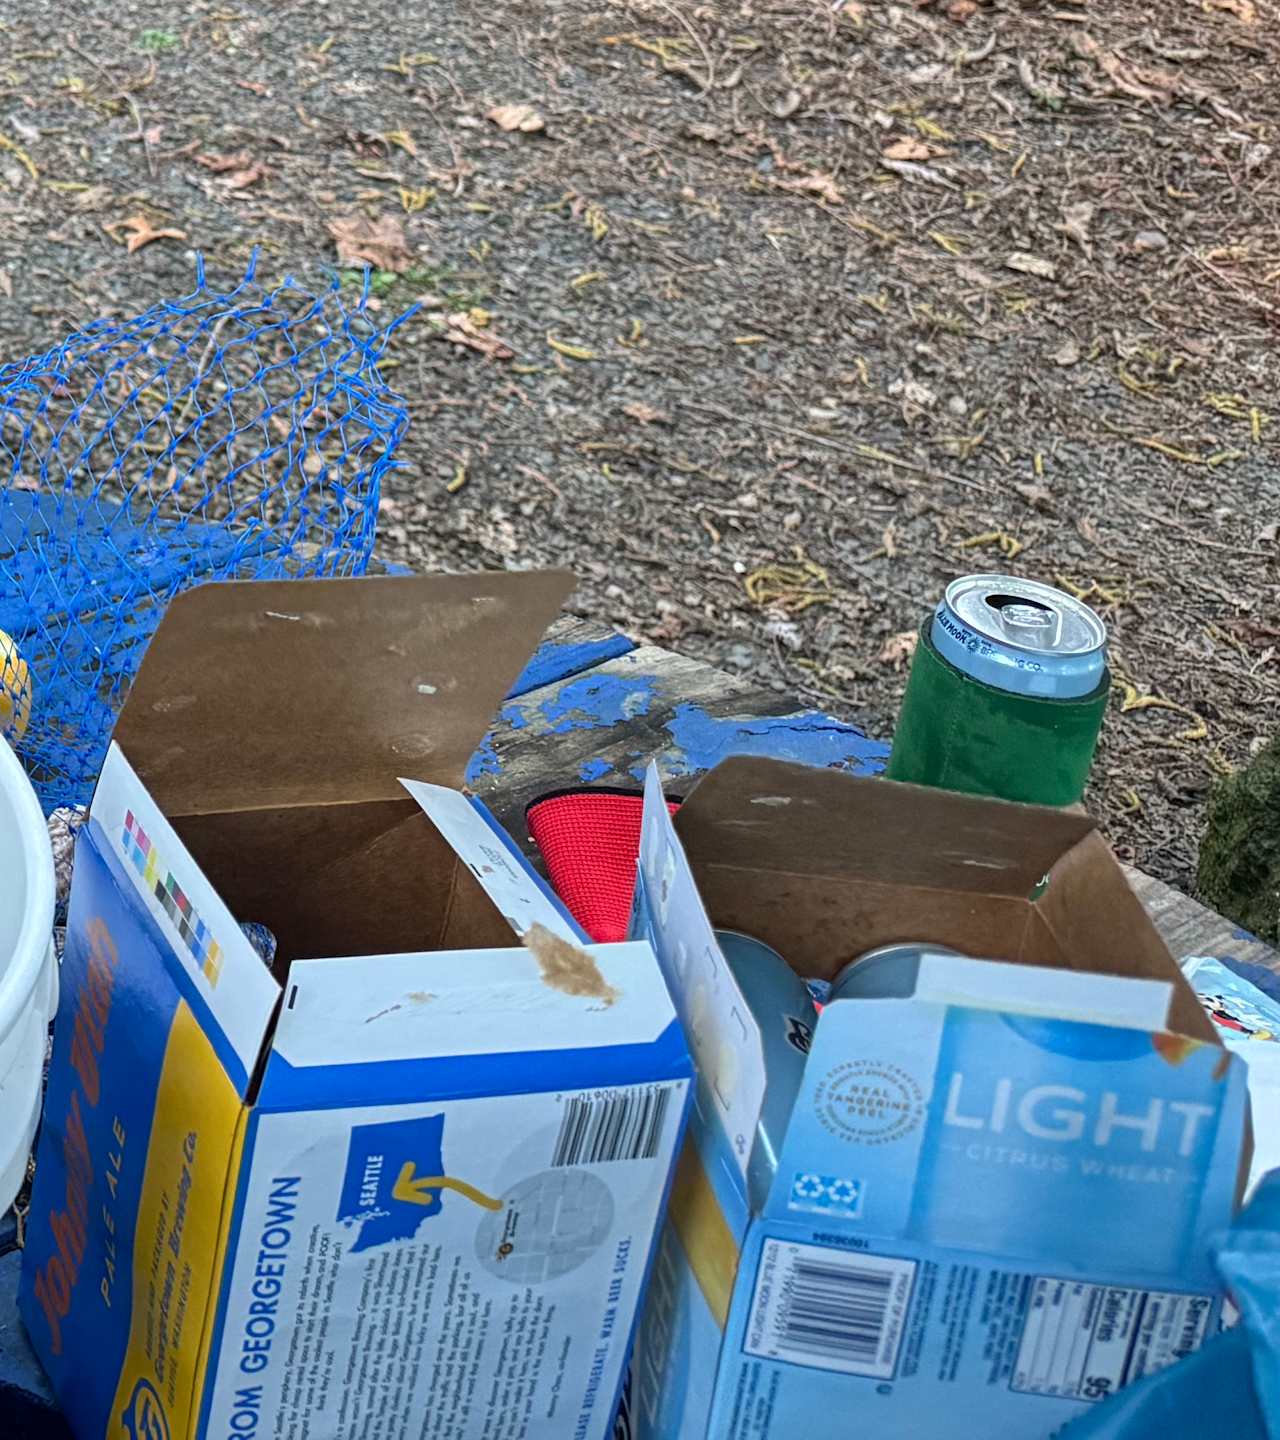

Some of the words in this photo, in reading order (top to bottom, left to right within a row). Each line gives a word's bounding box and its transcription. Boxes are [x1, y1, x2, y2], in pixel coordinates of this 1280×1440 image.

[946, 624, 968, 644] MOON
[828, 1092, 911, 1113] TANGERINE
[944, 1071, 1214, 1157] LIGHT
[105, 1115, 126, 1198] ALE
[965, 1144, 1070, 1172] CITRUS
[1081, 1160, 1178, 1184] WHEAT
[359, 1153, 384, 1207] SEATTLE
[167, 1162, 193, 1263] Brewing
[101, 1204, 118, 1308] PALE
[240, 1174, 304, 1374] GEORGETOWN
[761, 1261, 777, 1285] BLUE
[606, 1277, 624, 1303] BEER
[757, 1283, 773, 1310] MOON
[599, 1306, 617, 1340] WARM
[753, 1309, 767, 1334] LIGHT
[1098, 1289, 1124, 1343] Calories
[1082, 1374, 1111, 1401] 95
